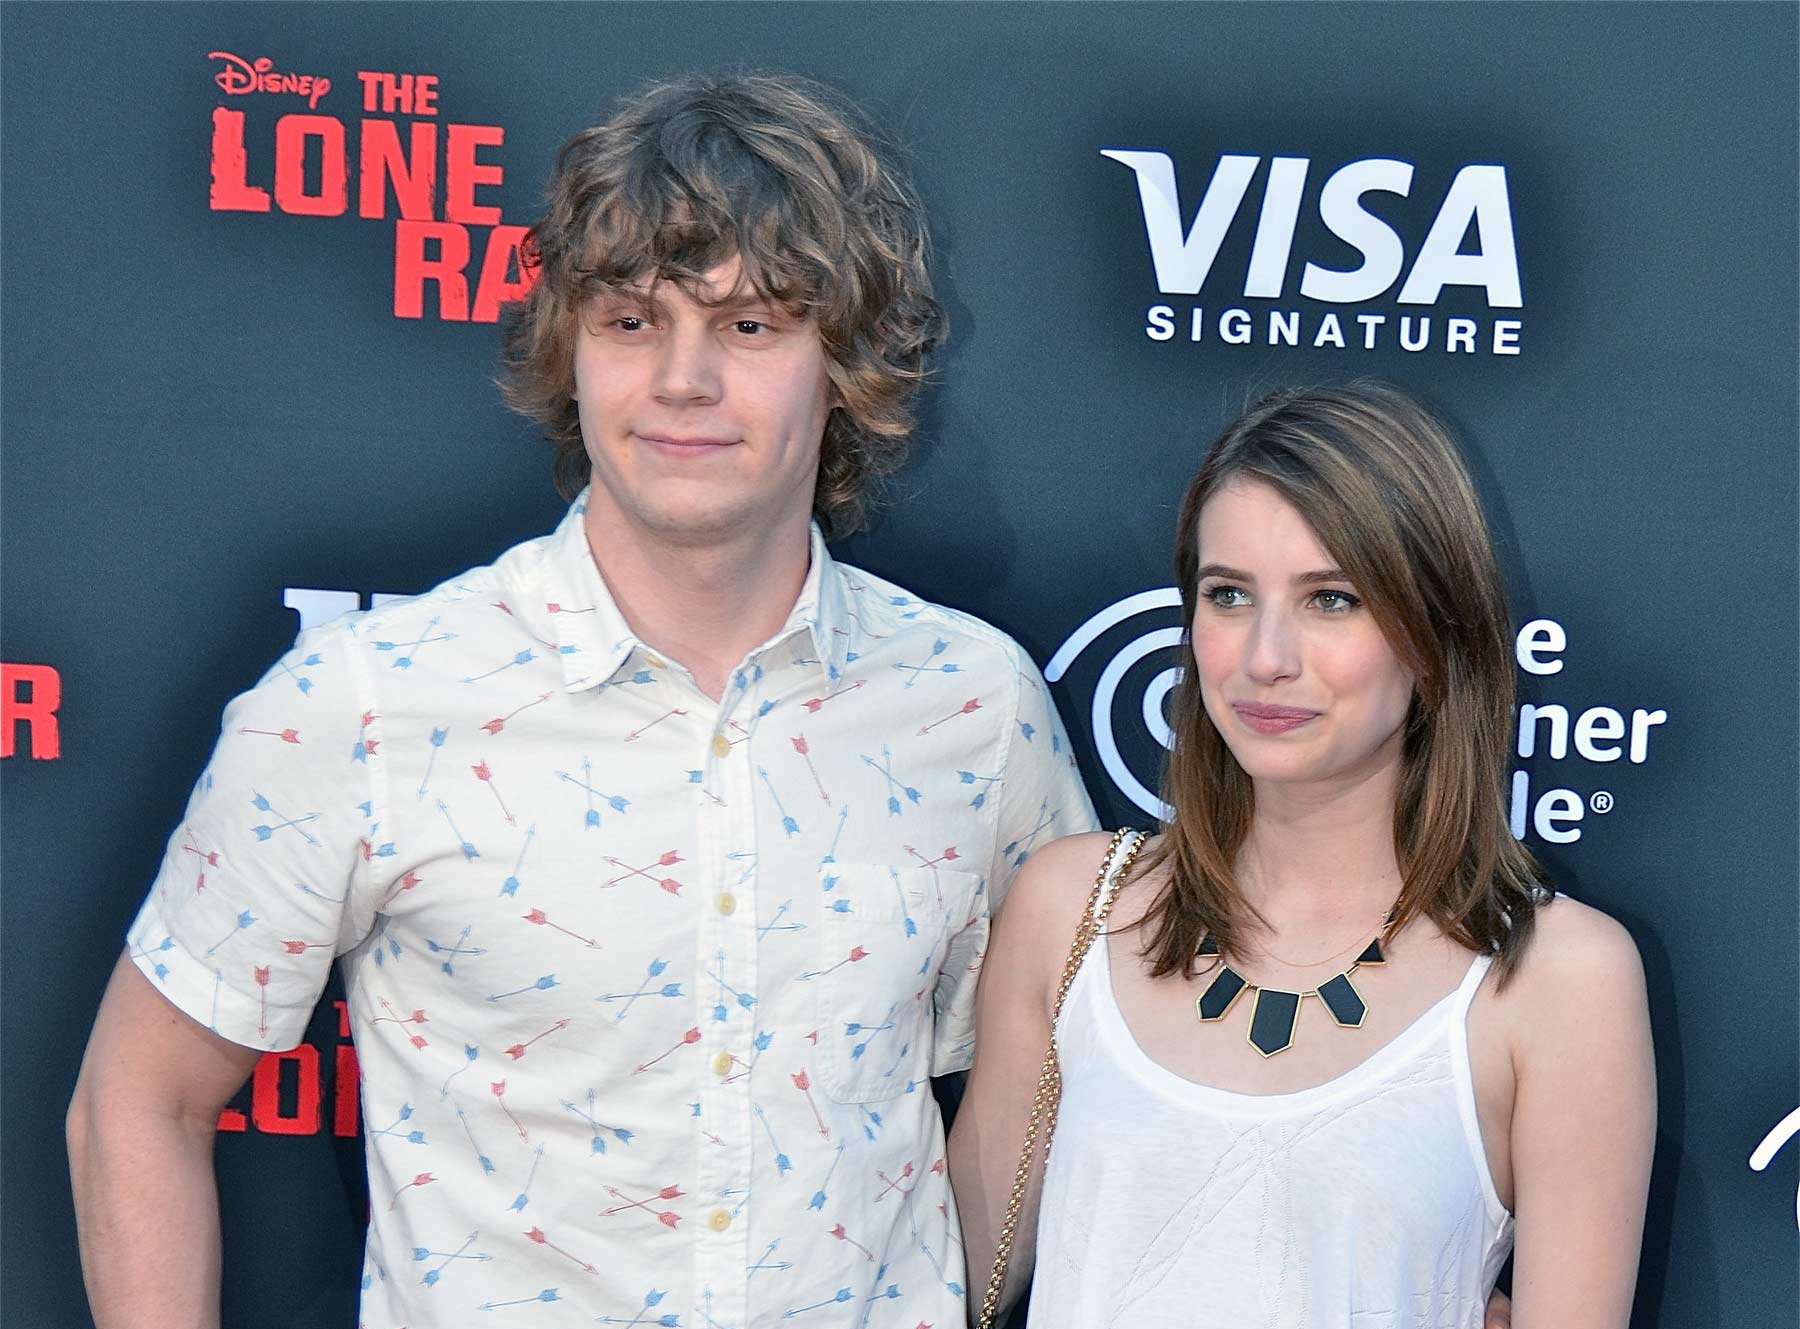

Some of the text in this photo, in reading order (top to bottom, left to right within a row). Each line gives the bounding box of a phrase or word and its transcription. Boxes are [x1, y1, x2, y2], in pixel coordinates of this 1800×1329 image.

[357, 71, 440, 115] THE
[209, 106, 505, 226] LONE
[1099, 149, 1524, 308] VISA
[394, 219, 543, 324] RA
[1146, 305, 1522, 355] SIGNATURE
[1517, 703, 1668, 764] ner
